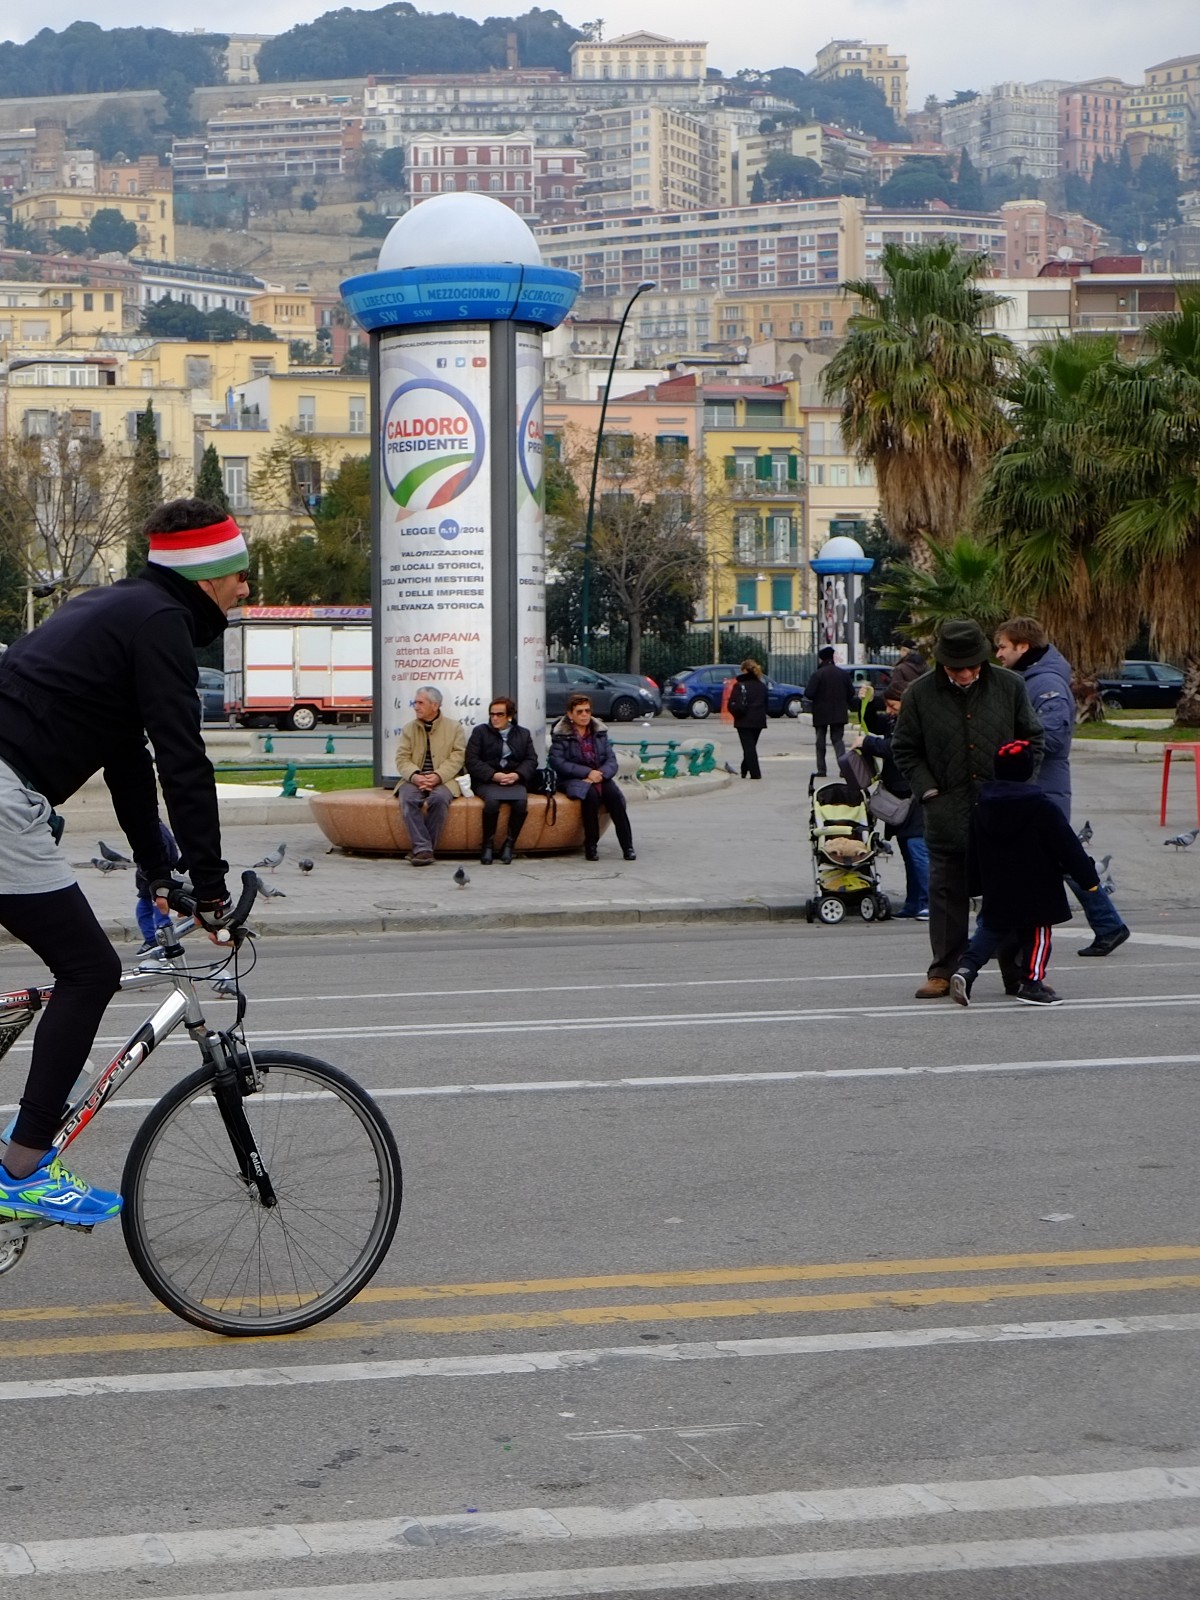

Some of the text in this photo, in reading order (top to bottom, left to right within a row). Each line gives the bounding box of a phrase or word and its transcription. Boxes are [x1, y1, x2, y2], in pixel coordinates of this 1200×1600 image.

[427, 287, 500, 300] MEZZOGIORNO
[521, 289, 565, 304] SCIROCCO
[362, 291, 405, 308] LIBECCIO
[379, 309, 399, 323] SW
[413, 308, 433, 318] SSW
[458, 305, 469, 317] S
[528, 306, 546, 319] SE
[387, 416, 469, 439] CALDORO
[387, 438, 469, 454] PRESIDENTE
[400, 527, 436, 536] LEGGE
[402, 562, 435, 571] LOCALI
[437, 562, 485, 571] STORICI,
[382, 575, 484, 586] DEGLI ANTICHI MESTIERI
[405, 589, 434, 598] DELLE
[436, 589, 485, 597] IMPRESE
[391, 603, 435, 611] RILEVANZA
[437, 602, 485, 610] STORICA
[249, 608, 307, 617] NIGHT
[384, 632, 481, 645] per una CAMPANIA
[396, 646, 454, 656] attenta alla
[394, 658, 461, 669] TRADIZIONE
